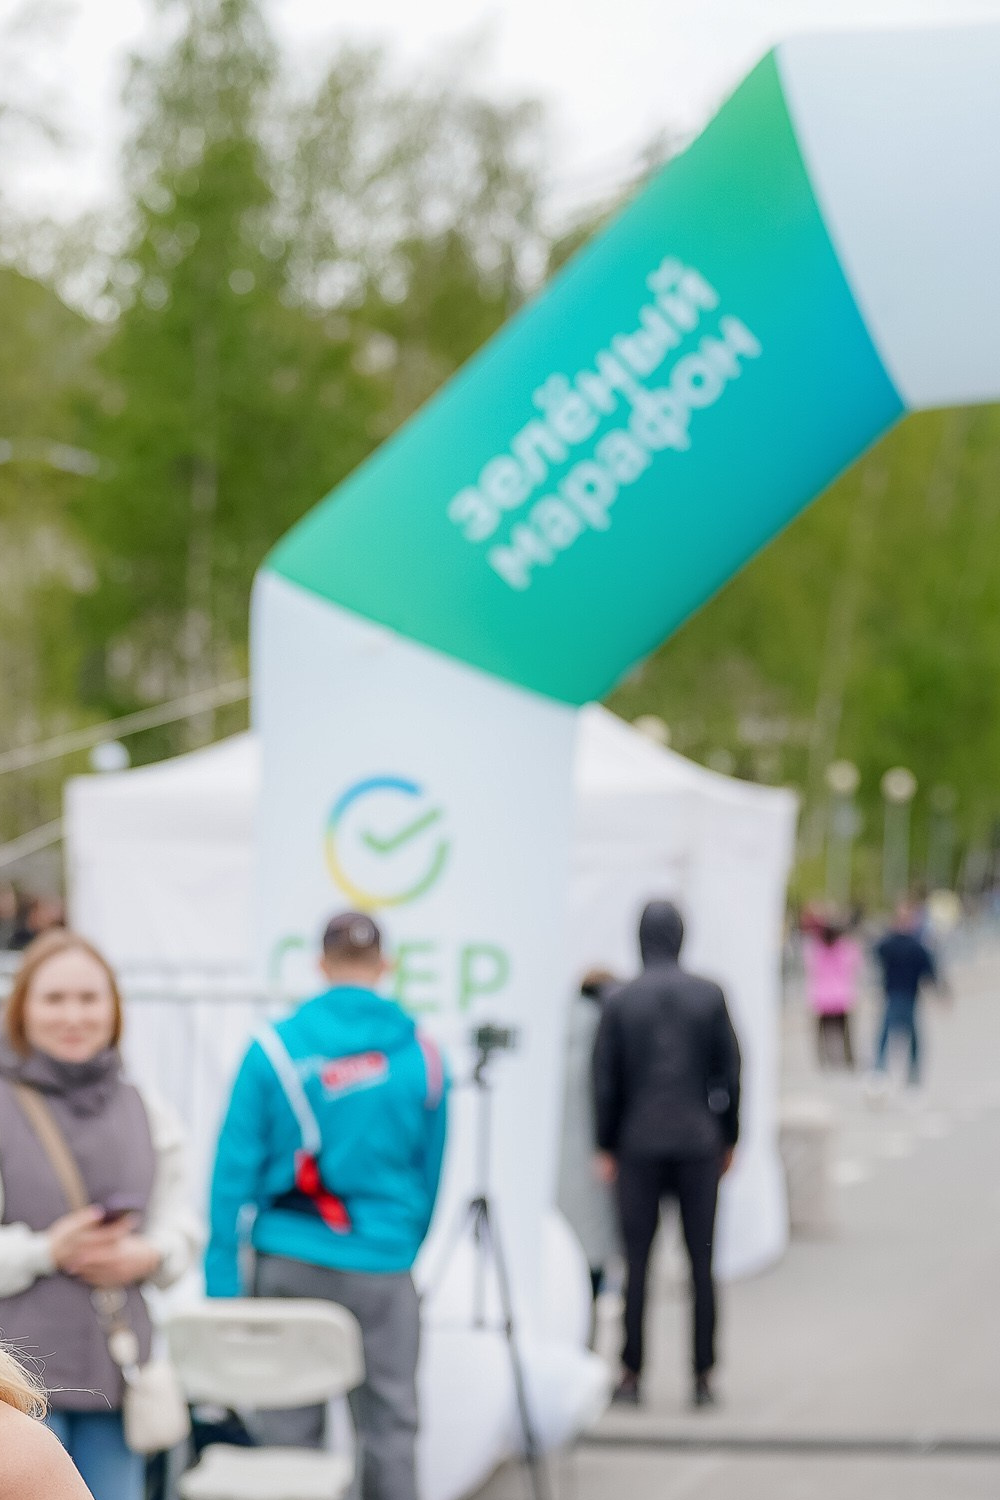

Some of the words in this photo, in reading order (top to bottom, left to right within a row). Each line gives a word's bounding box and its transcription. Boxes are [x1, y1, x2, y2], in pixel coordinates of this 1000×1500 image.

[448, 254, 721, 544] зелёный
[486, 313, 763, 592] марафон
[266, 934, 511, 1012] СЕР
